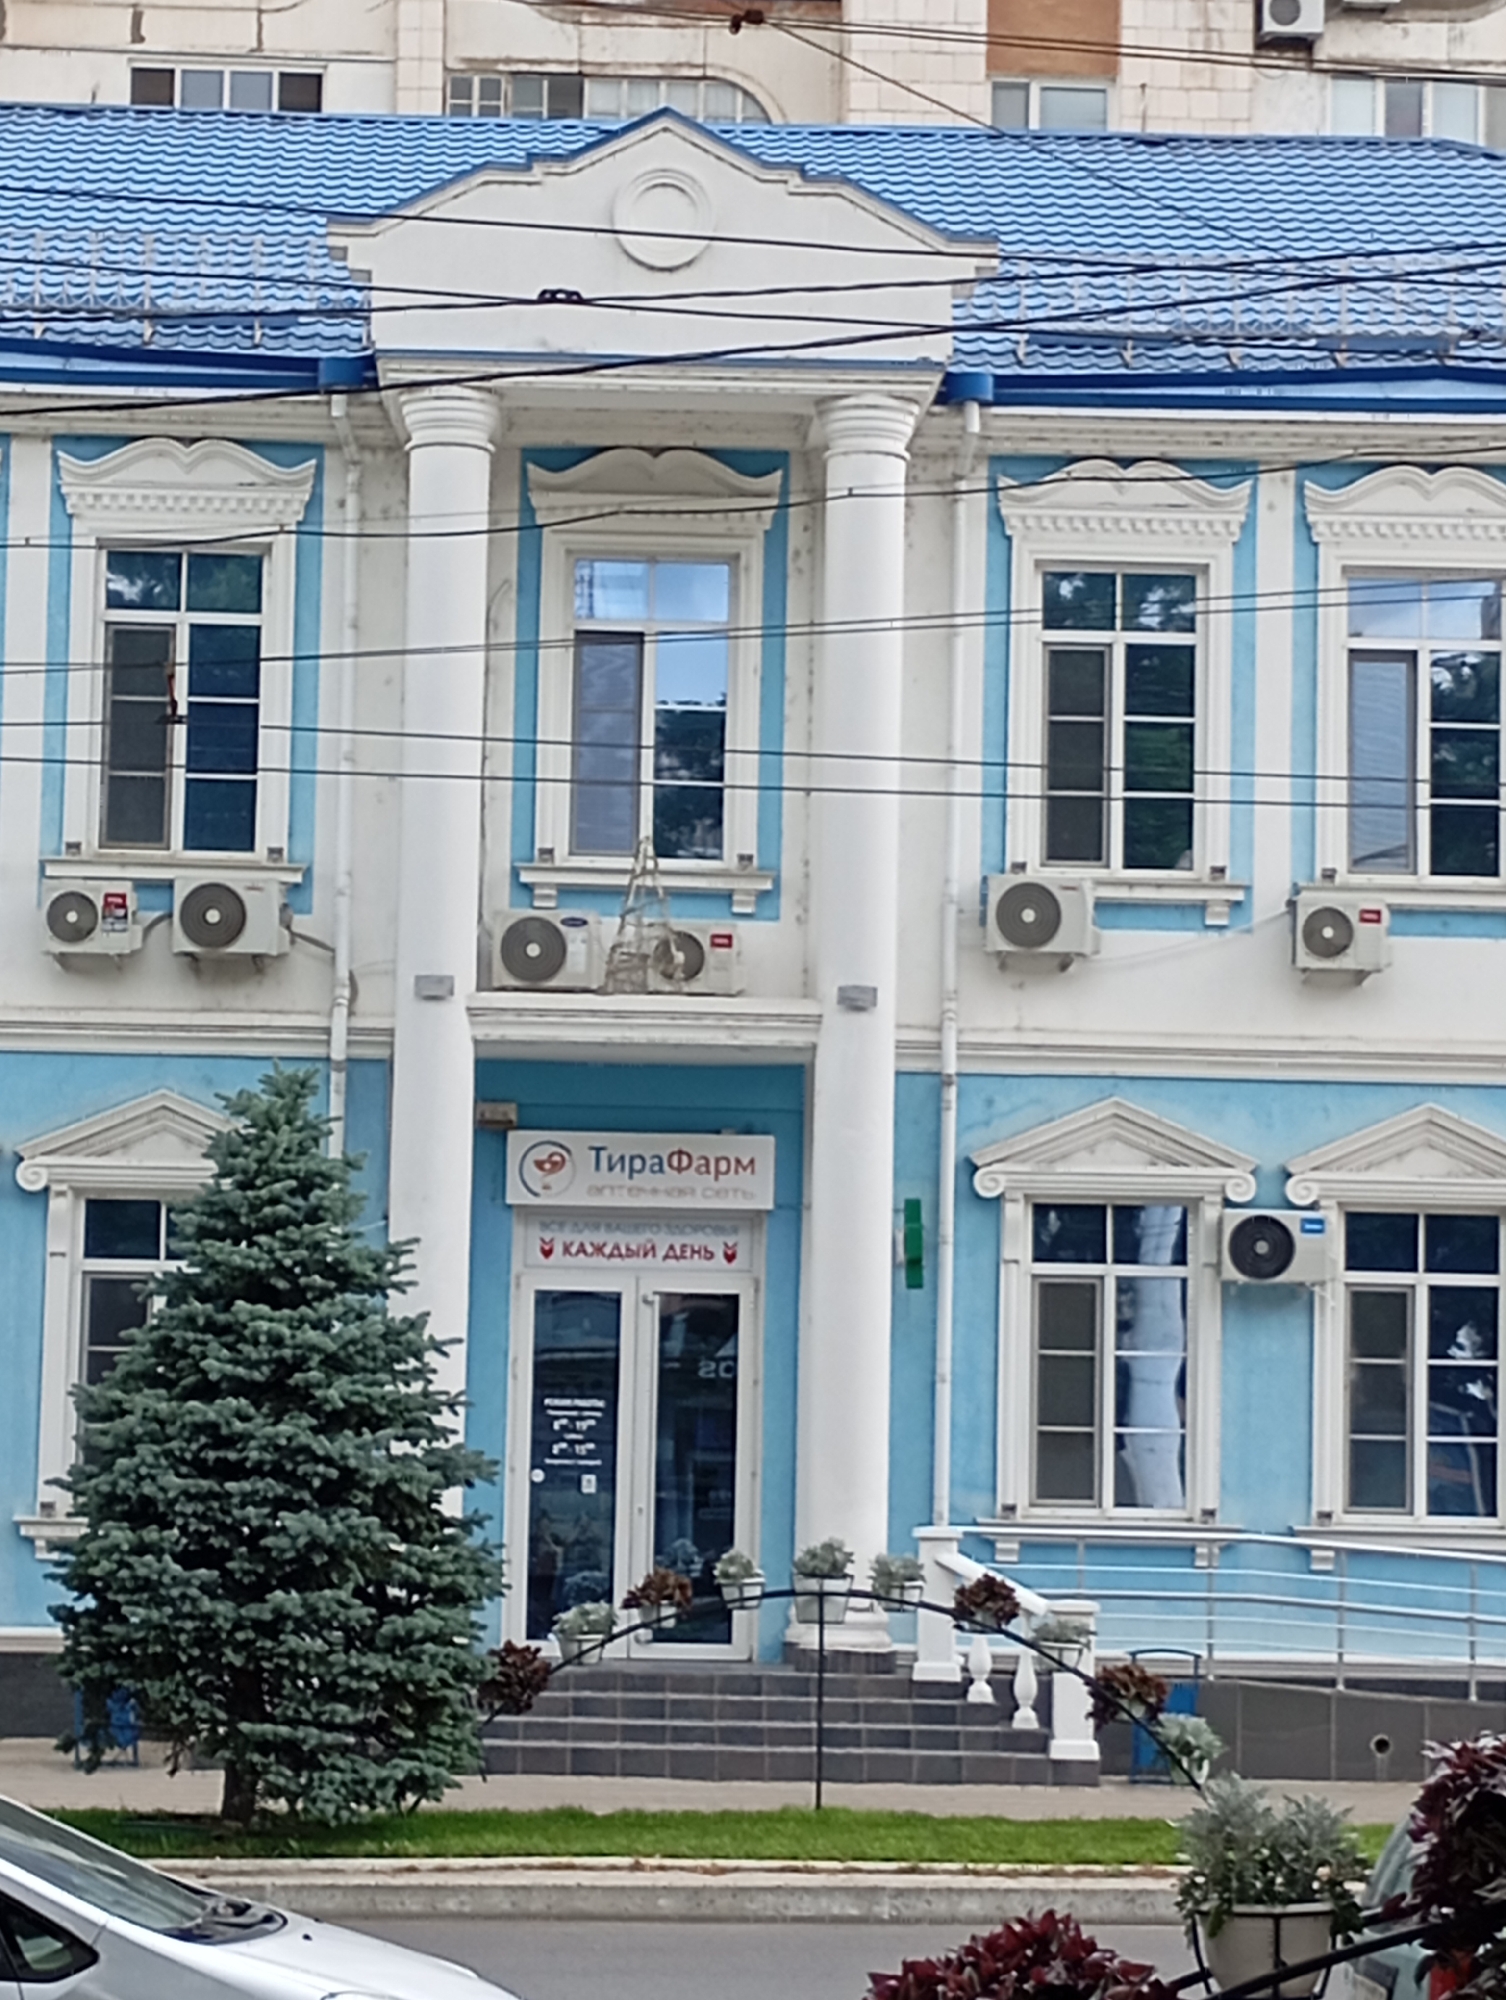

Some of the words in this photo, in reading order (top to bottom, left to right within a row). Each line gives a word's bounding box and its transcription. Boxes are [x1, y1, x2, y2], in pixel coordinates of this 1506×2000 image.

[587, 1145, 757, 1181] ТираФарм
[562, 1238, 657, 1260] КАЖДЫЙ
[662, 1243, 715, 1262] ДЕНЬ
